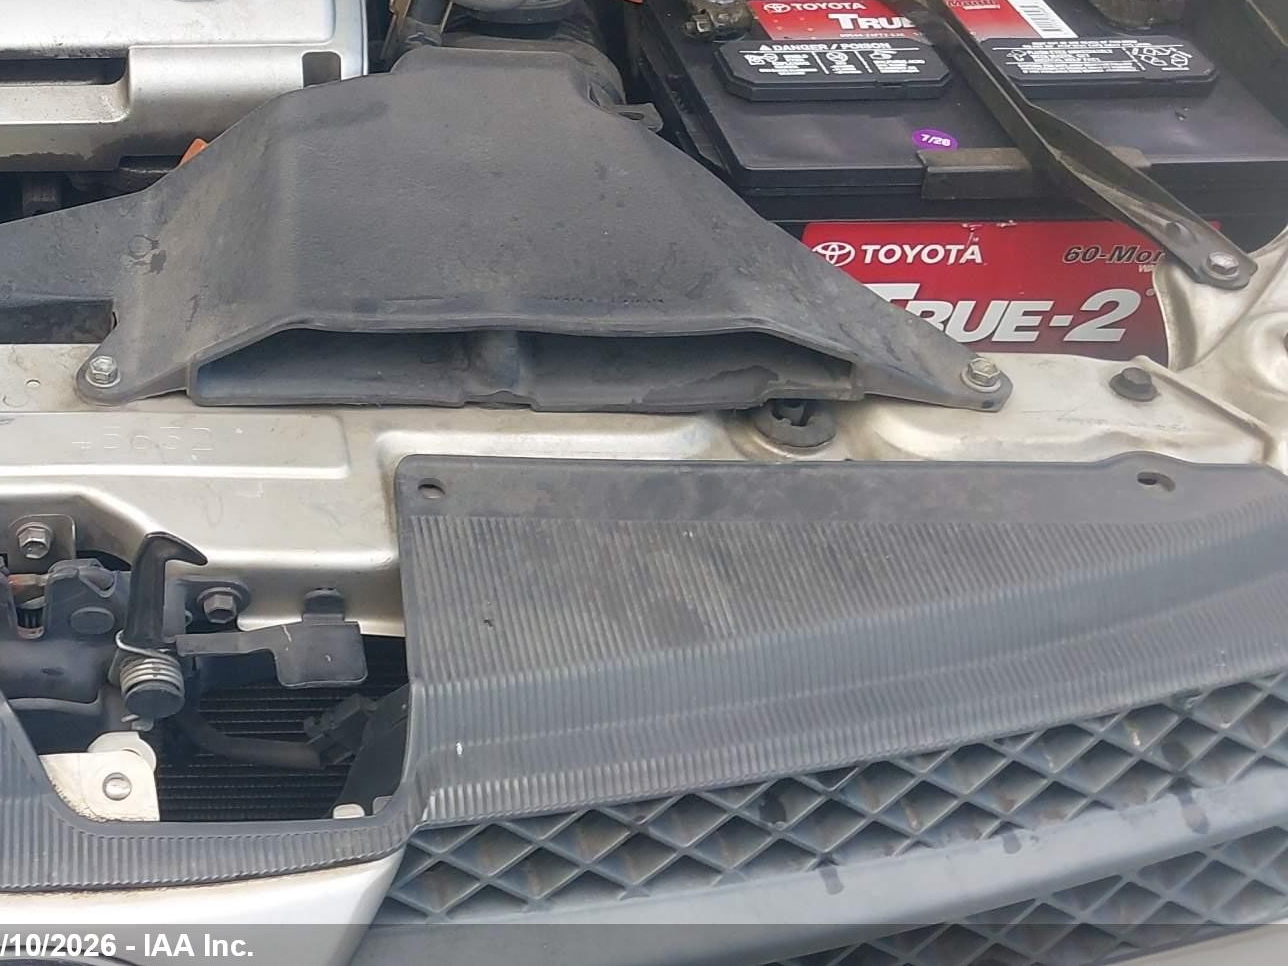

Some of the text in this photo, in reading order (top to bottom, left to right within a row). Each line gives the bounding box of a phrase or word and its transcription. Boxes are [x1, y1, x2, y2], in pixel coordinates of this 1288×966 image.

[790, 1, 867, 12] TOYOTA
[841, 41, 892, 51] POISON
[860, 244, 983, 265] TOYOTA
